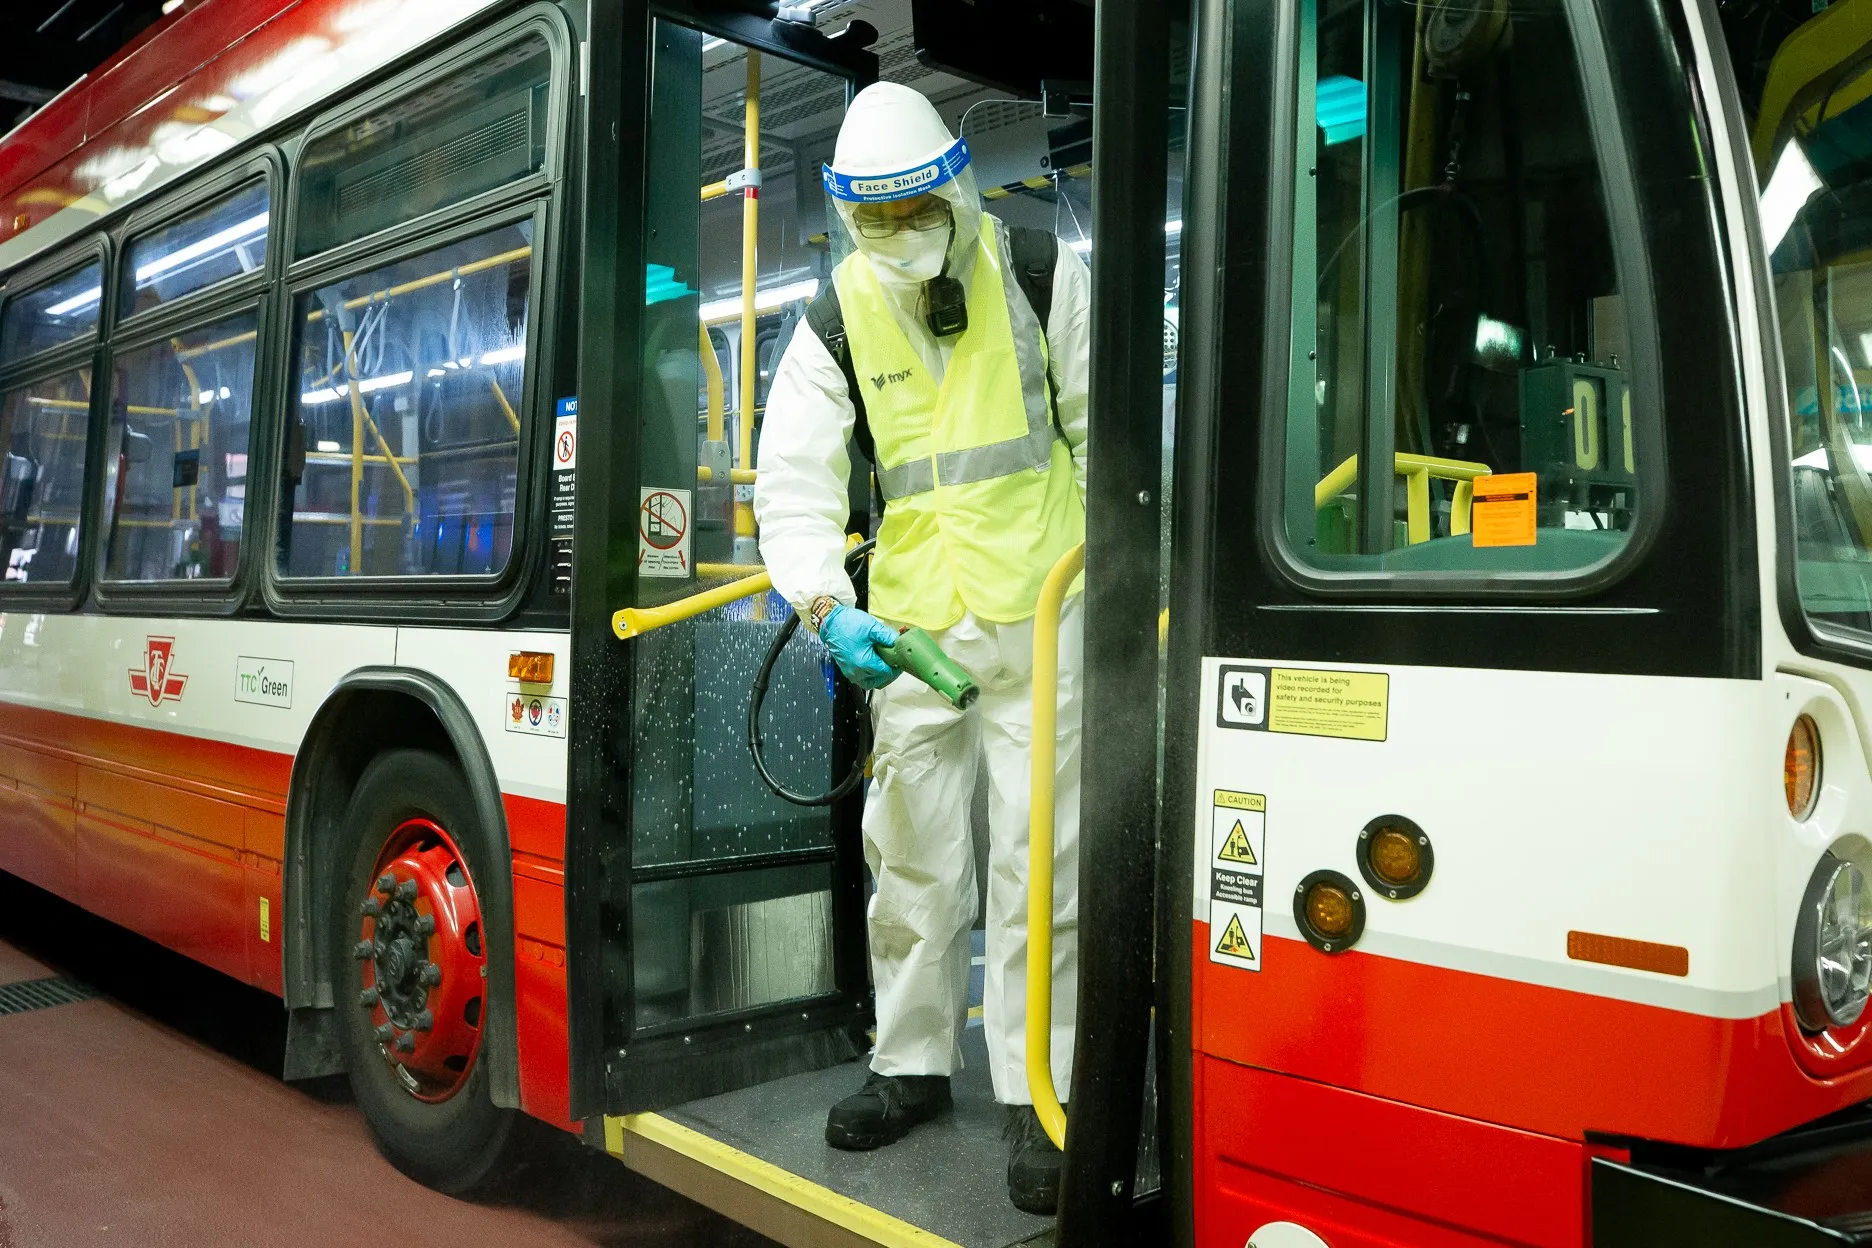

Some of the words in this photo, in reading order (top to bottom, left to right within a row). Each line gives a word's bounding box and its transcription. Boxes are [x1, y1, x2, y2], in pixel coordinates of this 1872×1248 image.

[858, 183, 888, 191] Face
[894, 169, 932, 188] Shield
[241, 674, 257, 693] TTC
[261, 676, 288, 697] Green
[1277, 673, 1292, 681] This
[1293, 675, 1319, 683] vehicle
[1329, 677, 1351, 687] being
[1331, 687, 1343, 695] for
[1276, 693, 1297, 703] safety
[1299, 695, 1312, 703] and
[1314, 697, 1344, 706] security
[1345, 699, 1382, 707] purposes
[1227, 795, 1262, 807] CAUTION
[1215, 871, 1236, 885] Keep
[1236, 875, 1258, 887] Clear
[1220, 883, 1243, 895] Kneeling
[1242, 887, 1254, 895] bus
